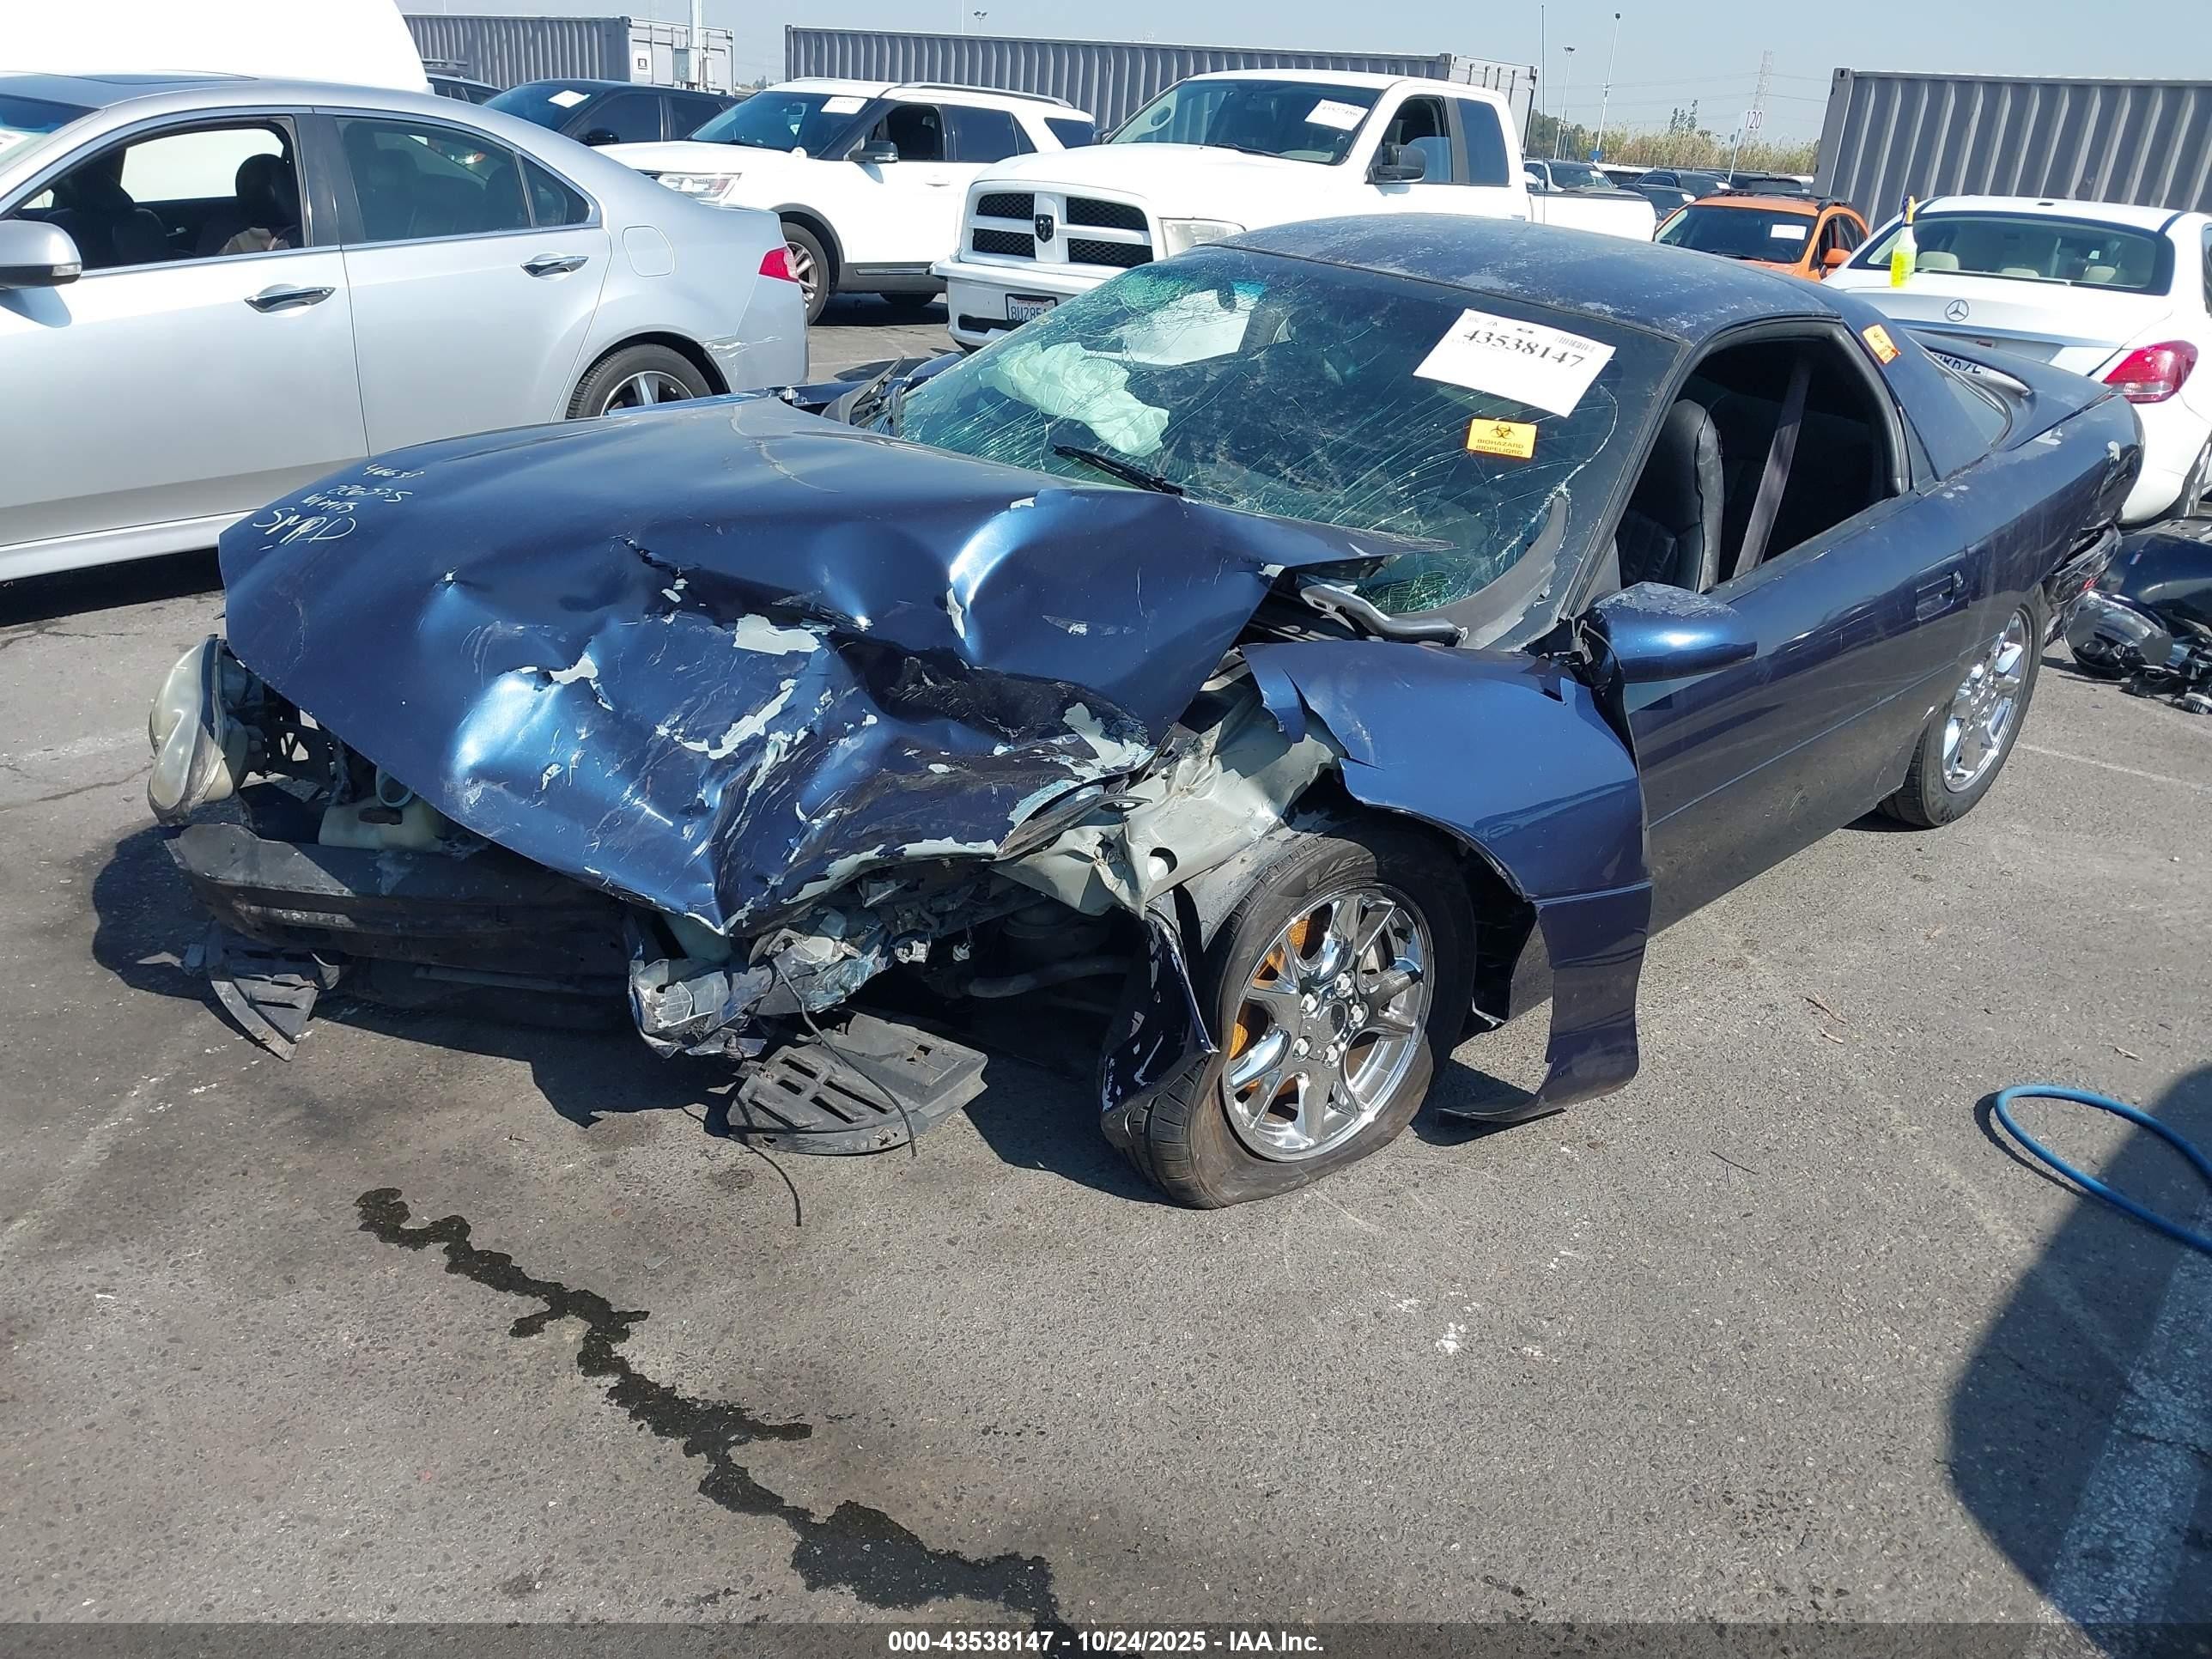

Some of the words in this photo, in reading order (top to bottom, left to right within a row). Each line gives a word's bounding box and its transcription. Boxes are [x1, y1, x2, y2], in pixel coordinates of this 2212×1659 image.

[1745, 111, 1763, 130] 120
[1010, 306, 1042, 322] 8U285
[1463, 330, 1586, 368] 43538147
[1475, 445, 1523, 455] BIOPELIGRO
[1477, 438, 1524, 449] BIOHAZARD
